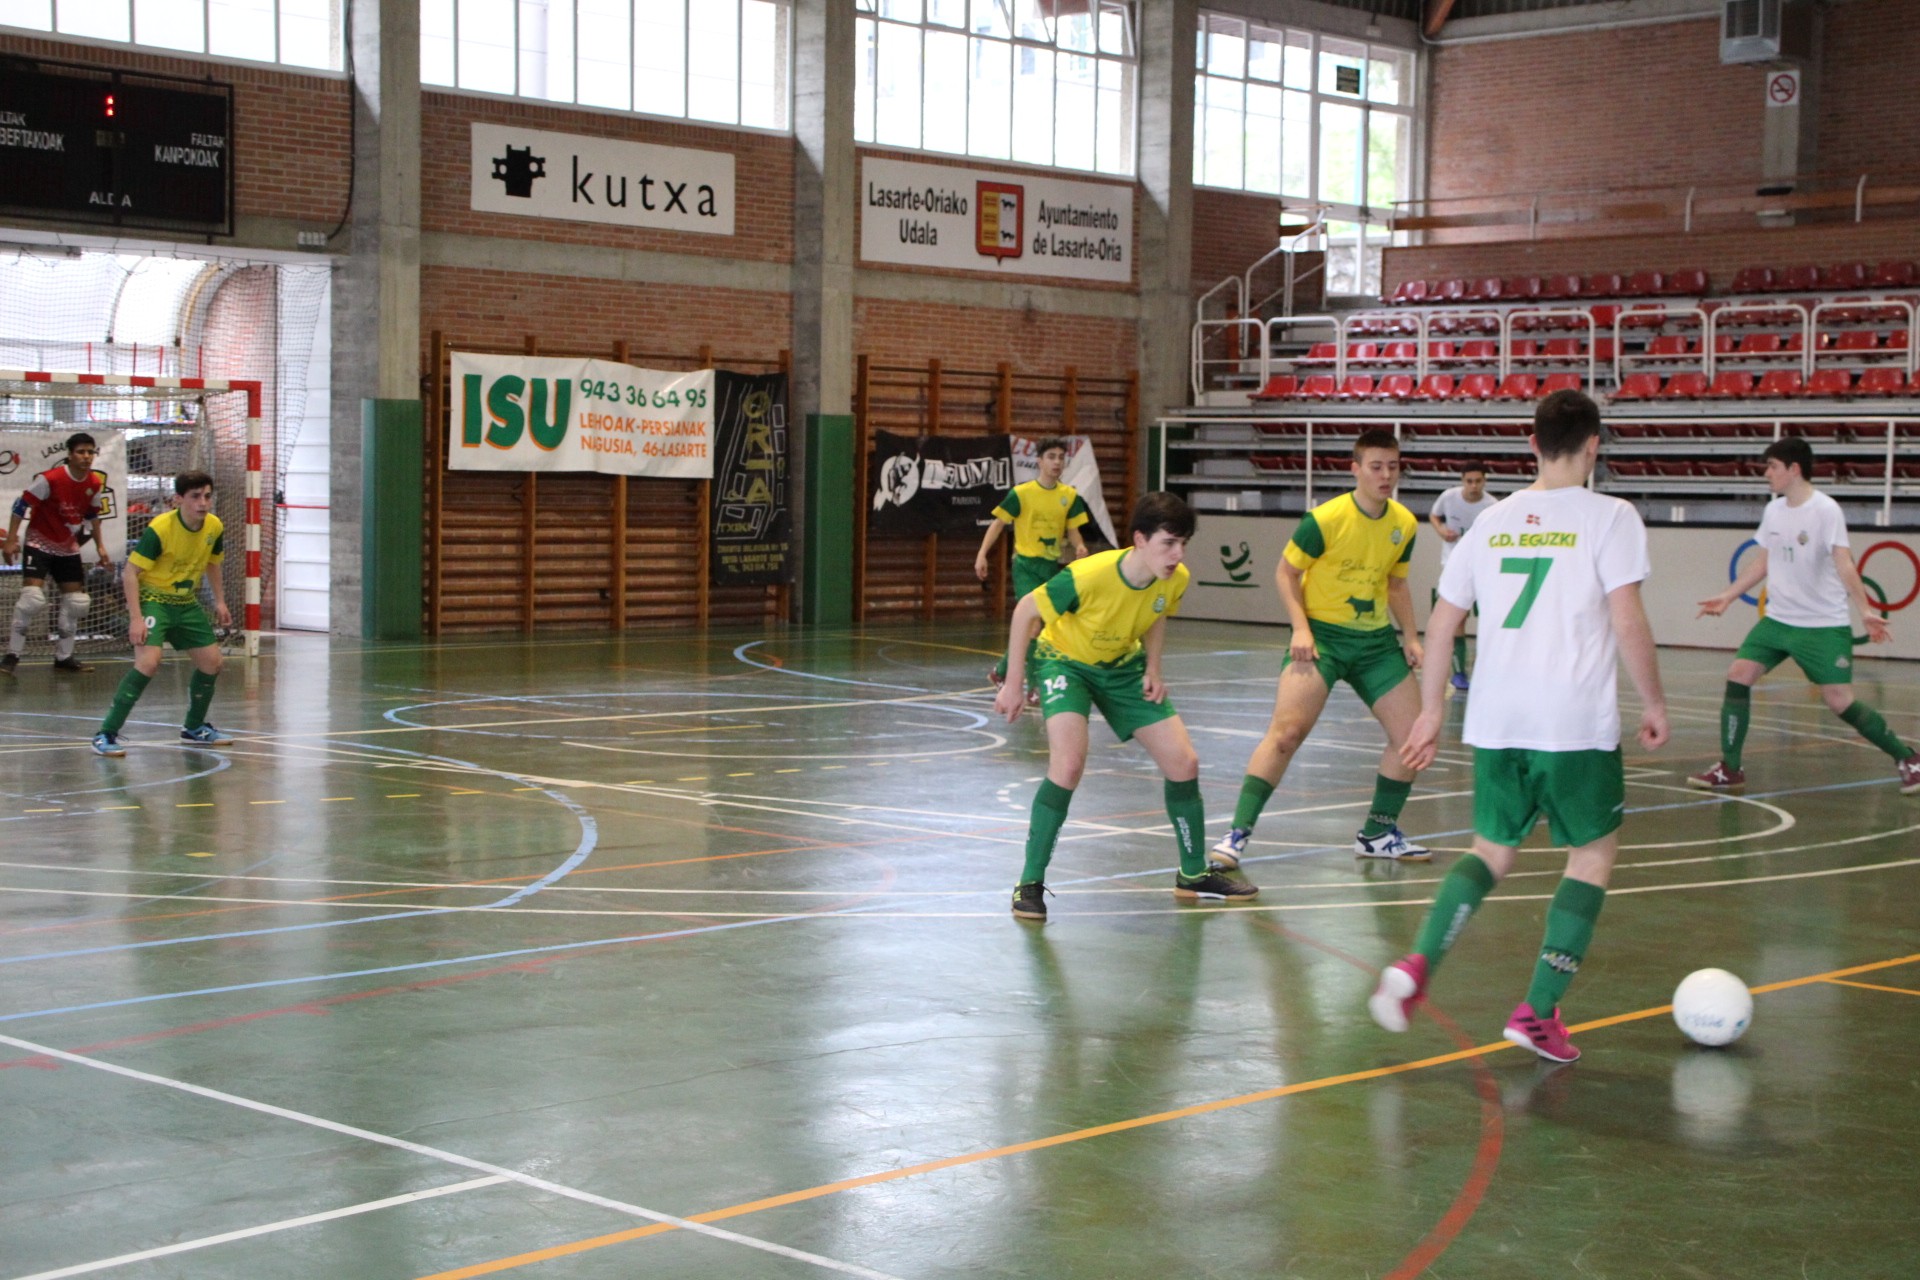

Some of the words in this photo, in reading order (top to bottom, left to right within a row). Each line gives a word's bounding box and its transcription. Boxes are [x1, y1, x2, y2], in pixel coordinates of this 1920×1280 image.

[0, 111, 26, 126] LTAK
[191, 133, 225, 148] FALTAK
[154, 144, 219, 168] KANPOKOAK
[572, 154, 717, 217] kutxa
[869, 181, 968, 216] Lasarte-Oriako
[1038, 200, 1118, 231] Ayuntamiento
[899, 219, 938, 246] Udala
[1033, 232, 1047, 255] de
[1051, 234, 1122, 262] Lasarte-Oria
[580, 378, 621, 402] 943
[625, 385, 647, 407] 36
[651, 390, 680, 408] 64
[685, 388, 707, 408] 95
[462, 373, 572, 451] ISU
[1489, 533, 1515, 548] C.D.
[1518, 532, 1577, 548] EGUZKI
[1500, 557, 1554, 629] 7
[1043, 674, 1068, 696] 14
